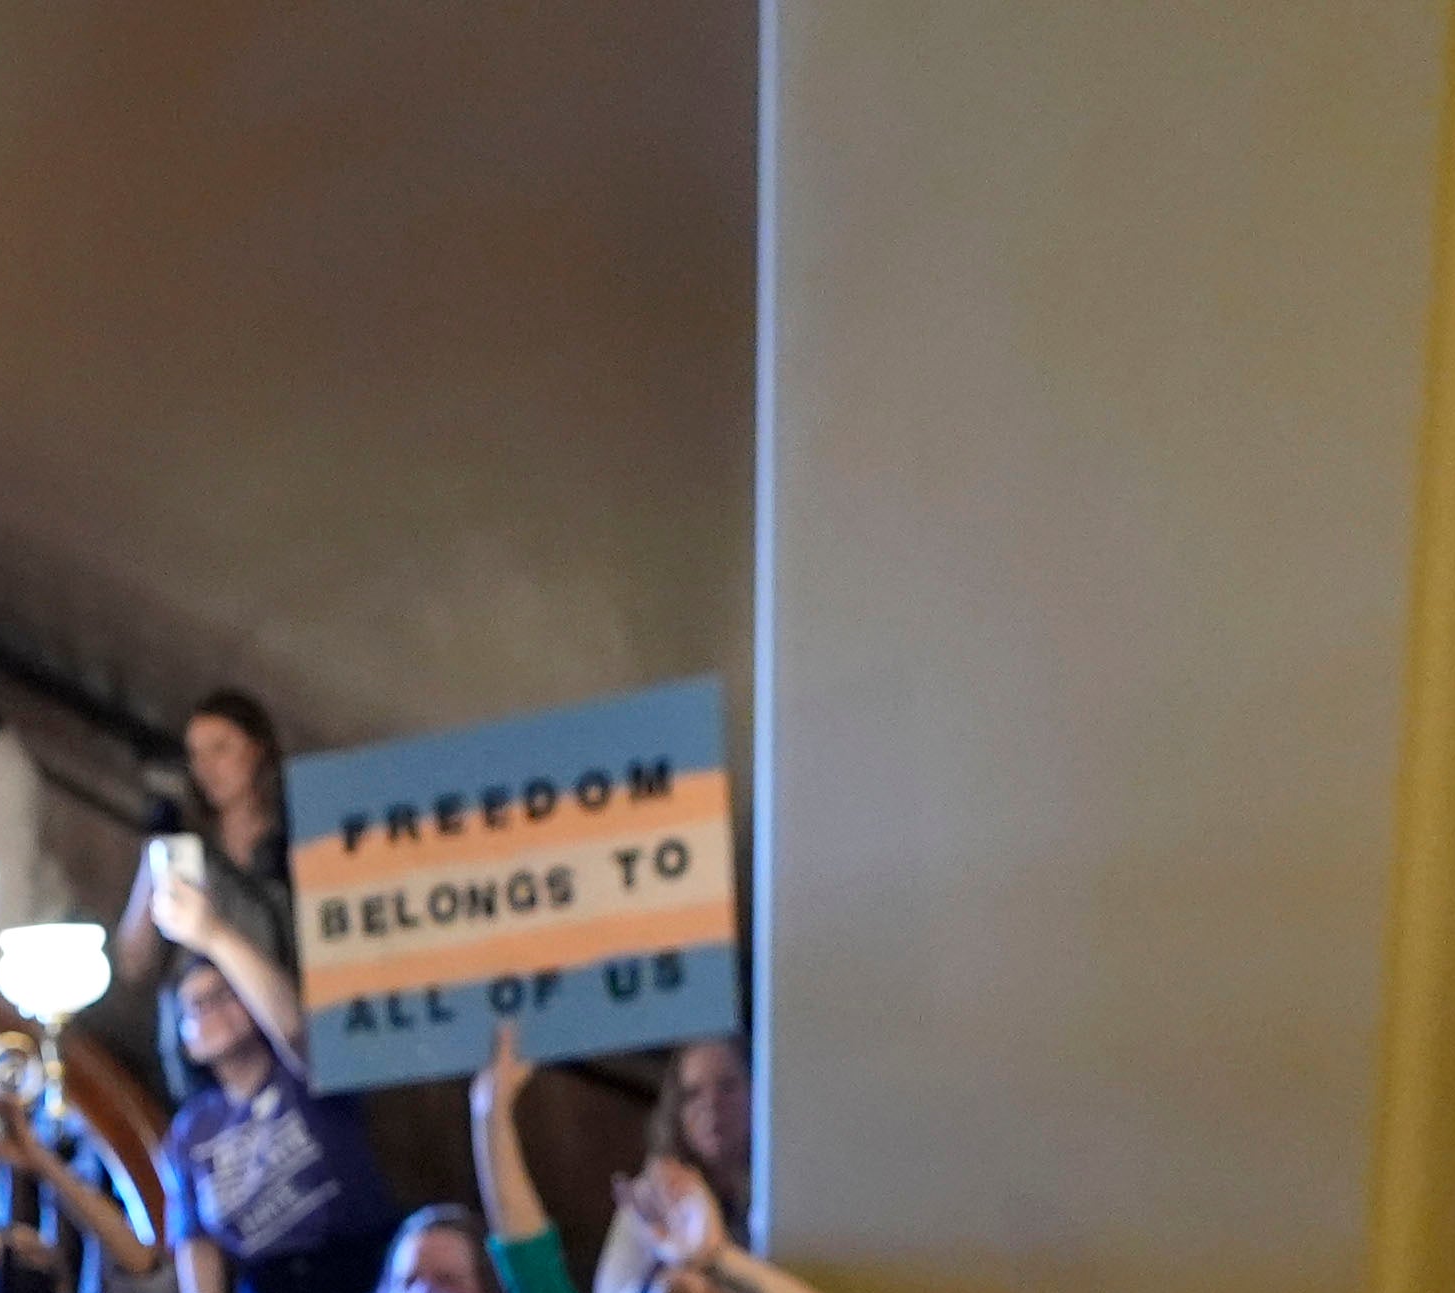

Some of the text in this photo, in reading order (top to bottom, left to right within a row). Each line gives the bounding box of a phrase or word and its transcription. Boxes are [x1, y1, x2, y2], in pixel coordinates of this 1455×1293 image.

[340, 755, 673, 851] FREEDOM
[319, 838, 690, 942] BELONGS TO
[344, 952, 685, 1034] ALL OF US
